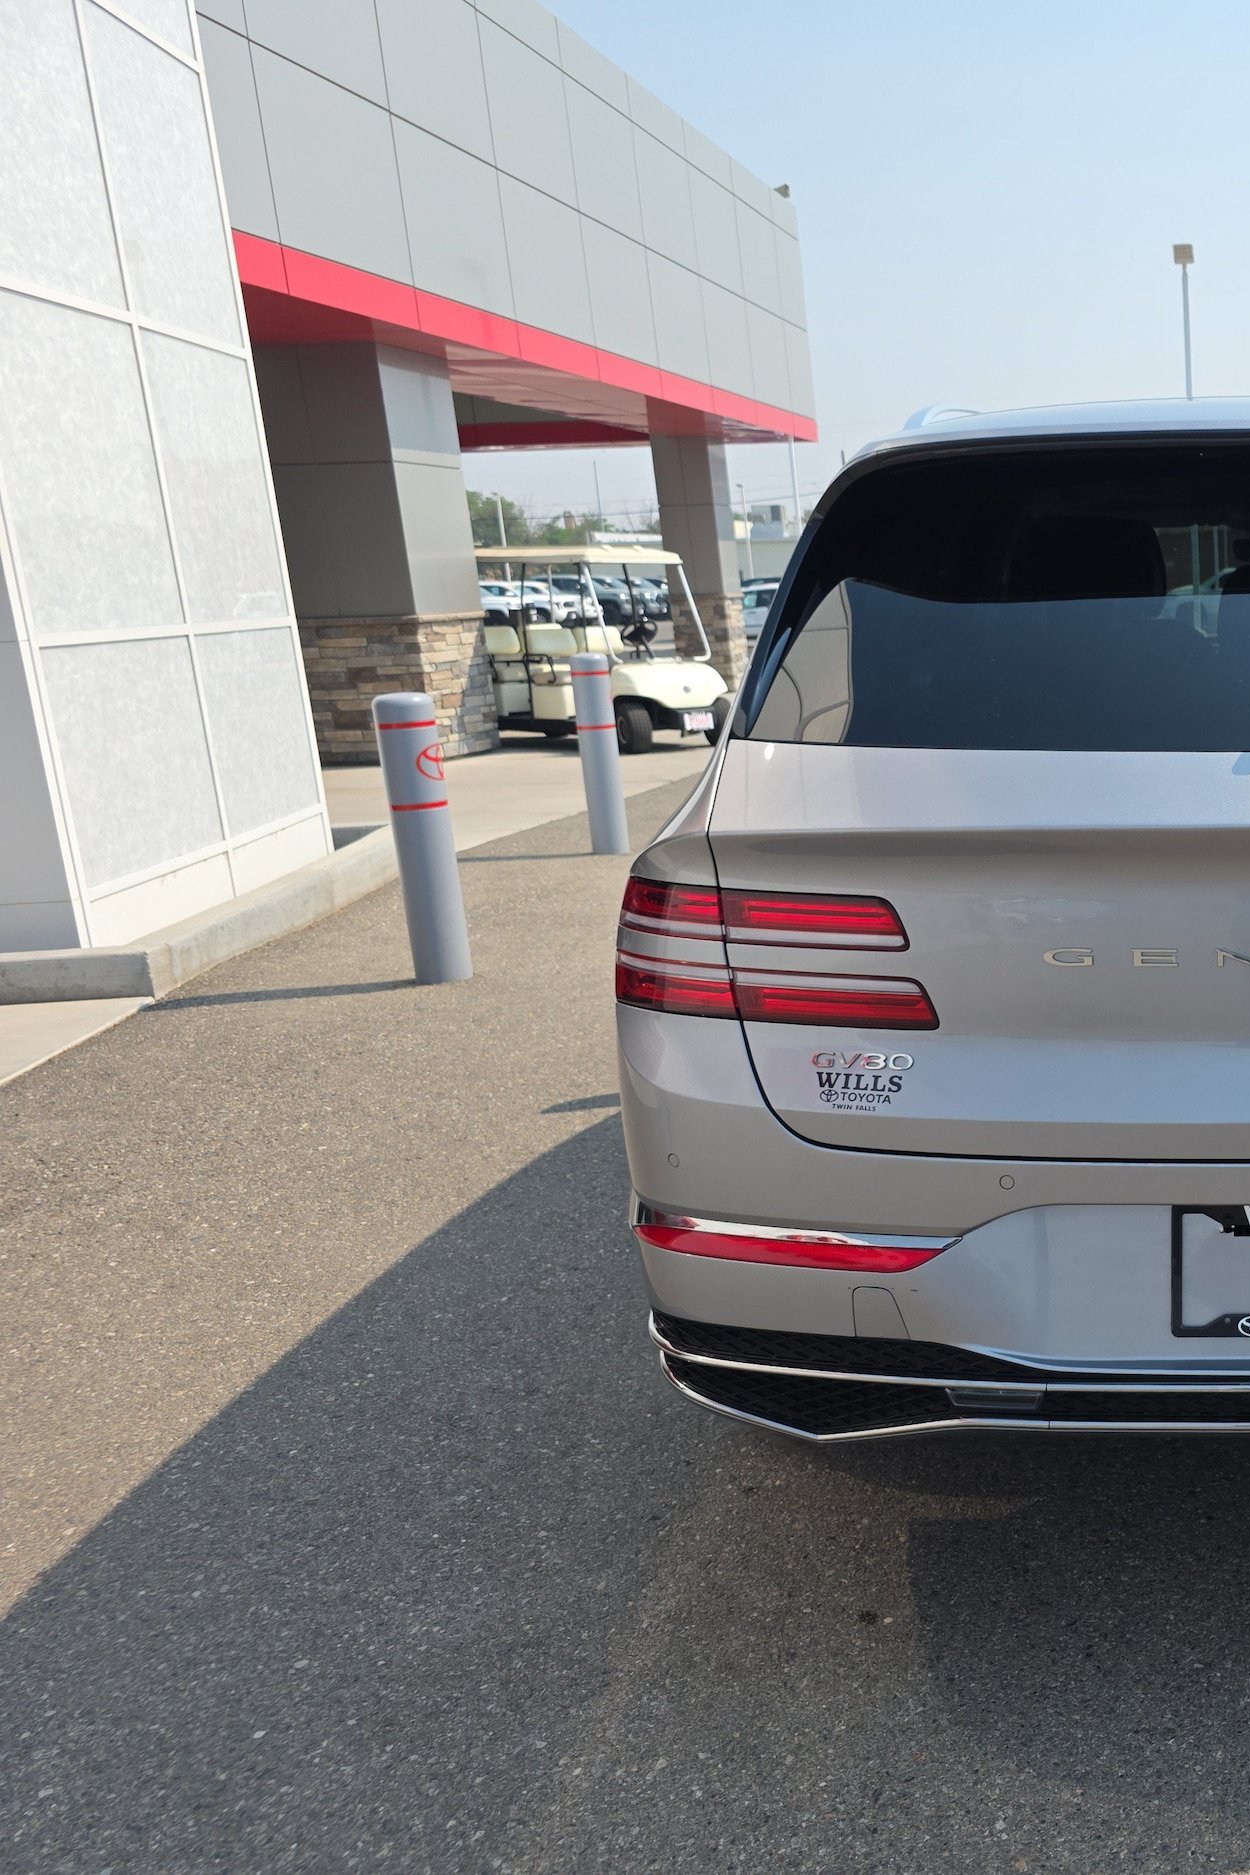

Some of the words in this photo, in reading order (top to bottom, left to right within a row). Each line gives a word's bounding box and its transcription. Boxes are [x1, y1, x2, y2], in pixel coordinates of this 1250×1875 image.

[810, 1051, 915, 1071] GV80
[816, 1071, 903, 1093] WILLS
[840, 1091, 892, 1105] TOYOTA
[855, 1104, 877, 1112] FALLS
